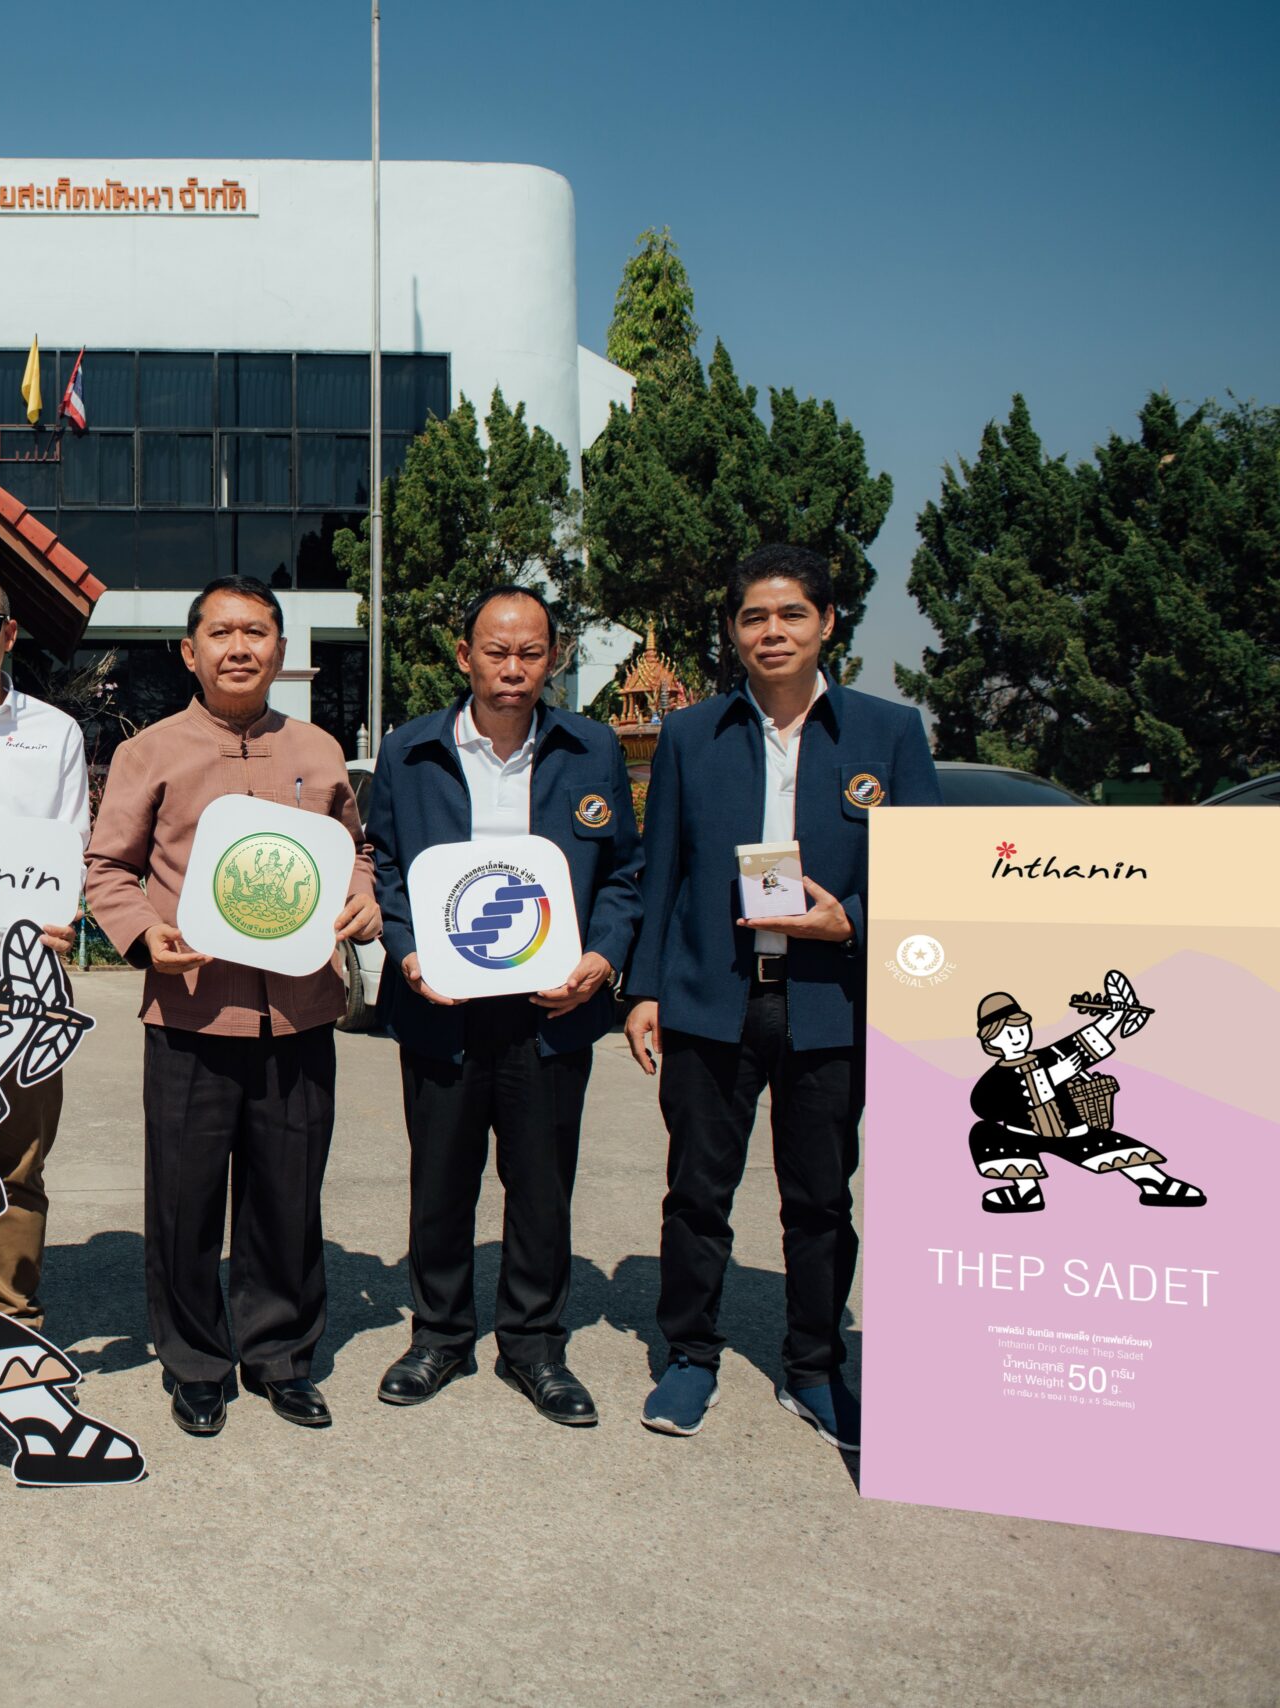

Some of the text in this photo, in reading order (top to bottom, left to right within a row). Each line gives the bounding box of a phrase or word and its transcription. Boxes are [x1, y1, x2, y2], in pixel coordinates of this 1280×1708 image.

[179, 177, 247, 210] จำกัด
[991, 856, 1147, 879] Inthanin
[884, 960, 957, 988] SPECIAL TASTE
[927, 1248, 1220, 1307] THEP SADET
[1037, 1343, 1057, 1354] Drip
[1059, 1345, 1089, 1356] Coffee
[1091, 1347, 1115, 1360] Thep
[1117, 1350, 1144, 1361] Sadet
[1003, 1372, 1122, 1395] Net Weight g.
[1068, 1364, 1107, 1393] 50
[1111, 1368, 1135, 1380] กรัม
